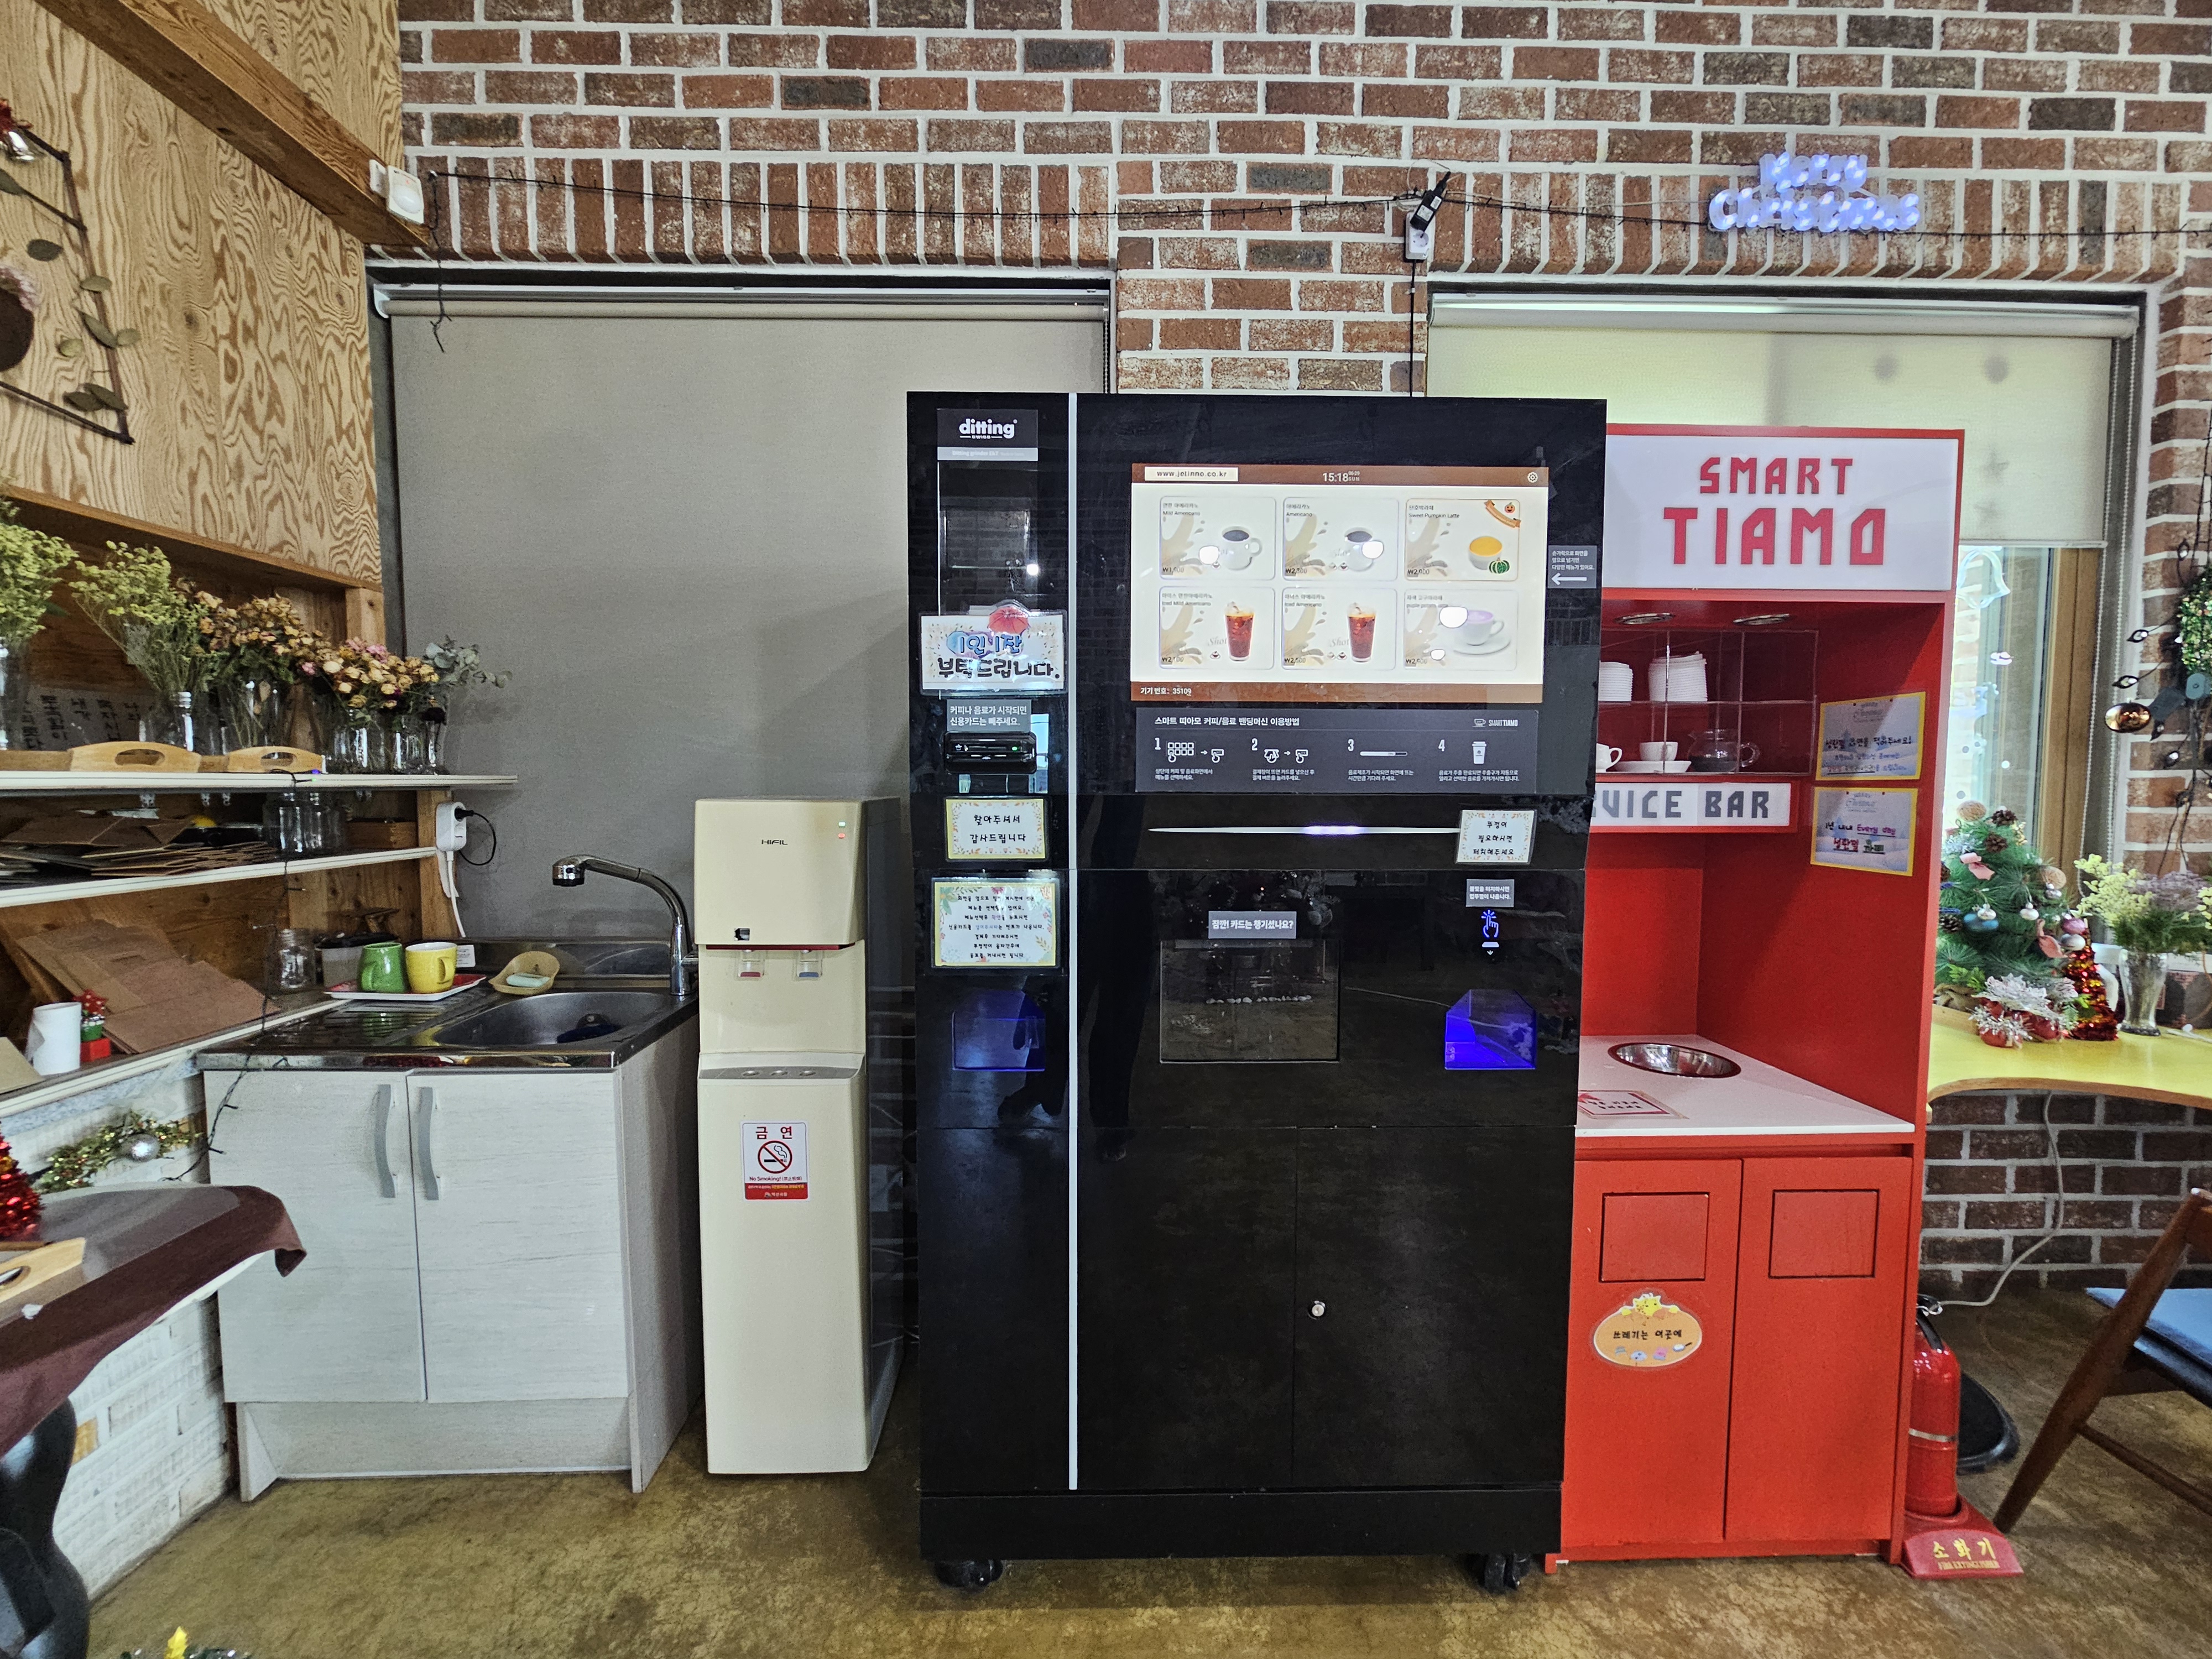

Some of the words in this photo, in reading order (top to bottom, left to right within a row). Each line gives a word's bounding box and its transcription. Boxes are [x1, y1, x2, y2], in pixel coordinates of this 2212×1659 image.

[959, 419, 1016, 439] ditting
[1323, 472, 1348, 482] 15:18
[1700, 457, 1853, 494] SMART
[1663, 507, 1886, 565] TIAMO
[950, 706, 972, 715] 커피나
[973, 706, 996, 715] 음료가
[998, 706, 1027, 715] 시작되면
[950, 717, 987, 726] 신용카드는
[988, 717, 1021, 726] 빼주세요.
[1155, 717, 1177, 726] 스마트
[1179, 717, 1201, 726] 띠아모
[1203, 717, 1237, 726] 커피/음료
[1270, 717, 1300, 726] 이용방법
[1155, 738, 1161, 750] 1
[1251, 738, 1258, 751] 2
[1348, 739, 1354, 752] 3
[1438, 739, 1446, 752] 4
[1593, 790, 1682, 818] VICE
[1705, 791, 1770, 818] BAR
[974, 815, 1020, 826] 찾아주셔서
[1486, 821, 1507, 829] 뚜껑이
[970, 834, 1026, 844] 감사드립니다
[1478, 834, 1512, 843] 필요하시면
[1212, 920, 1229, 930] 잠깐!
[1230, 920, 1252, 930] 카드는
[1253, 920, 1293, 930] 챙기셨나요?
[755, 1126, 768, 1140] 금
[780, 1126, 792, 1139] 연
[1613, 1330, 1648, 1340] 쓰레기는
[1933, 1537, 1996, 1561] 소화기
